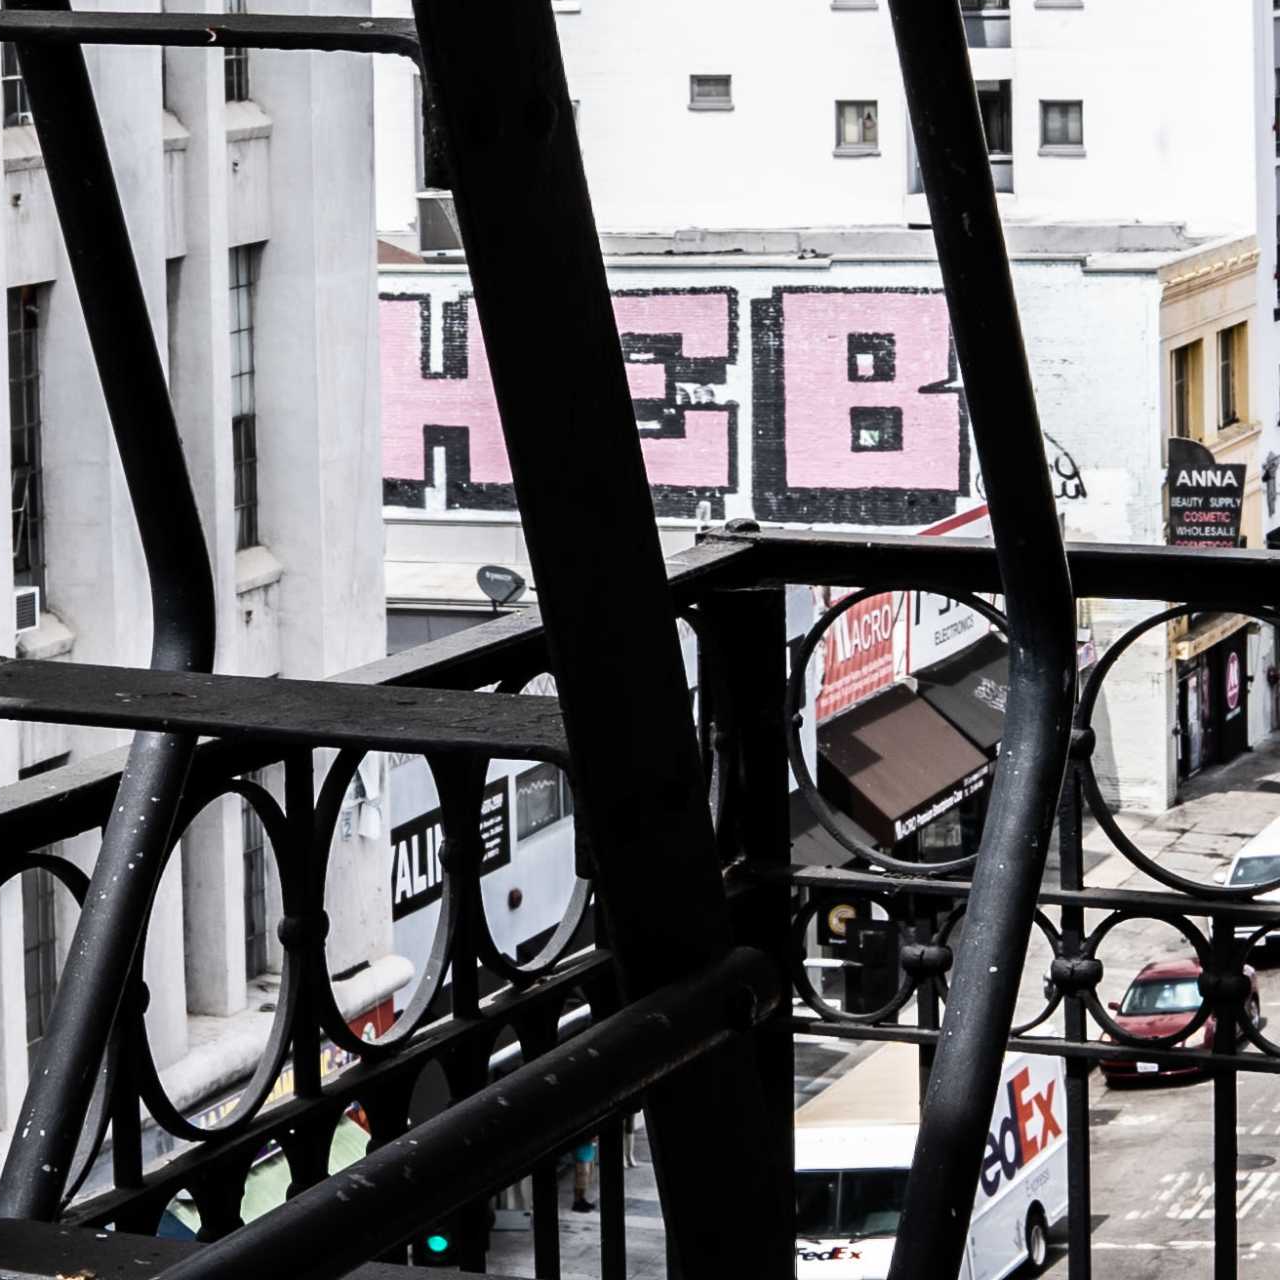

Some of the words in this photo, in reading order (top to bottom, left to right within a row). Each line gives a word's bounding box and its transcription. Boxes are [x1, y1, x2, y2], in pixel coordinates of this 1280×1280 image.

[1176, 470, 1238, 487] ANNA
[1171, 497, 1203, 507] BEAUTY
[1209, 497, 1241, 508] SUPPLY
[1183, 510, 1231, 523] COSMETIC
[1176, 526, 1236, 536] WHOLESALE
[981, 1066, 1062, 1197] edEx
